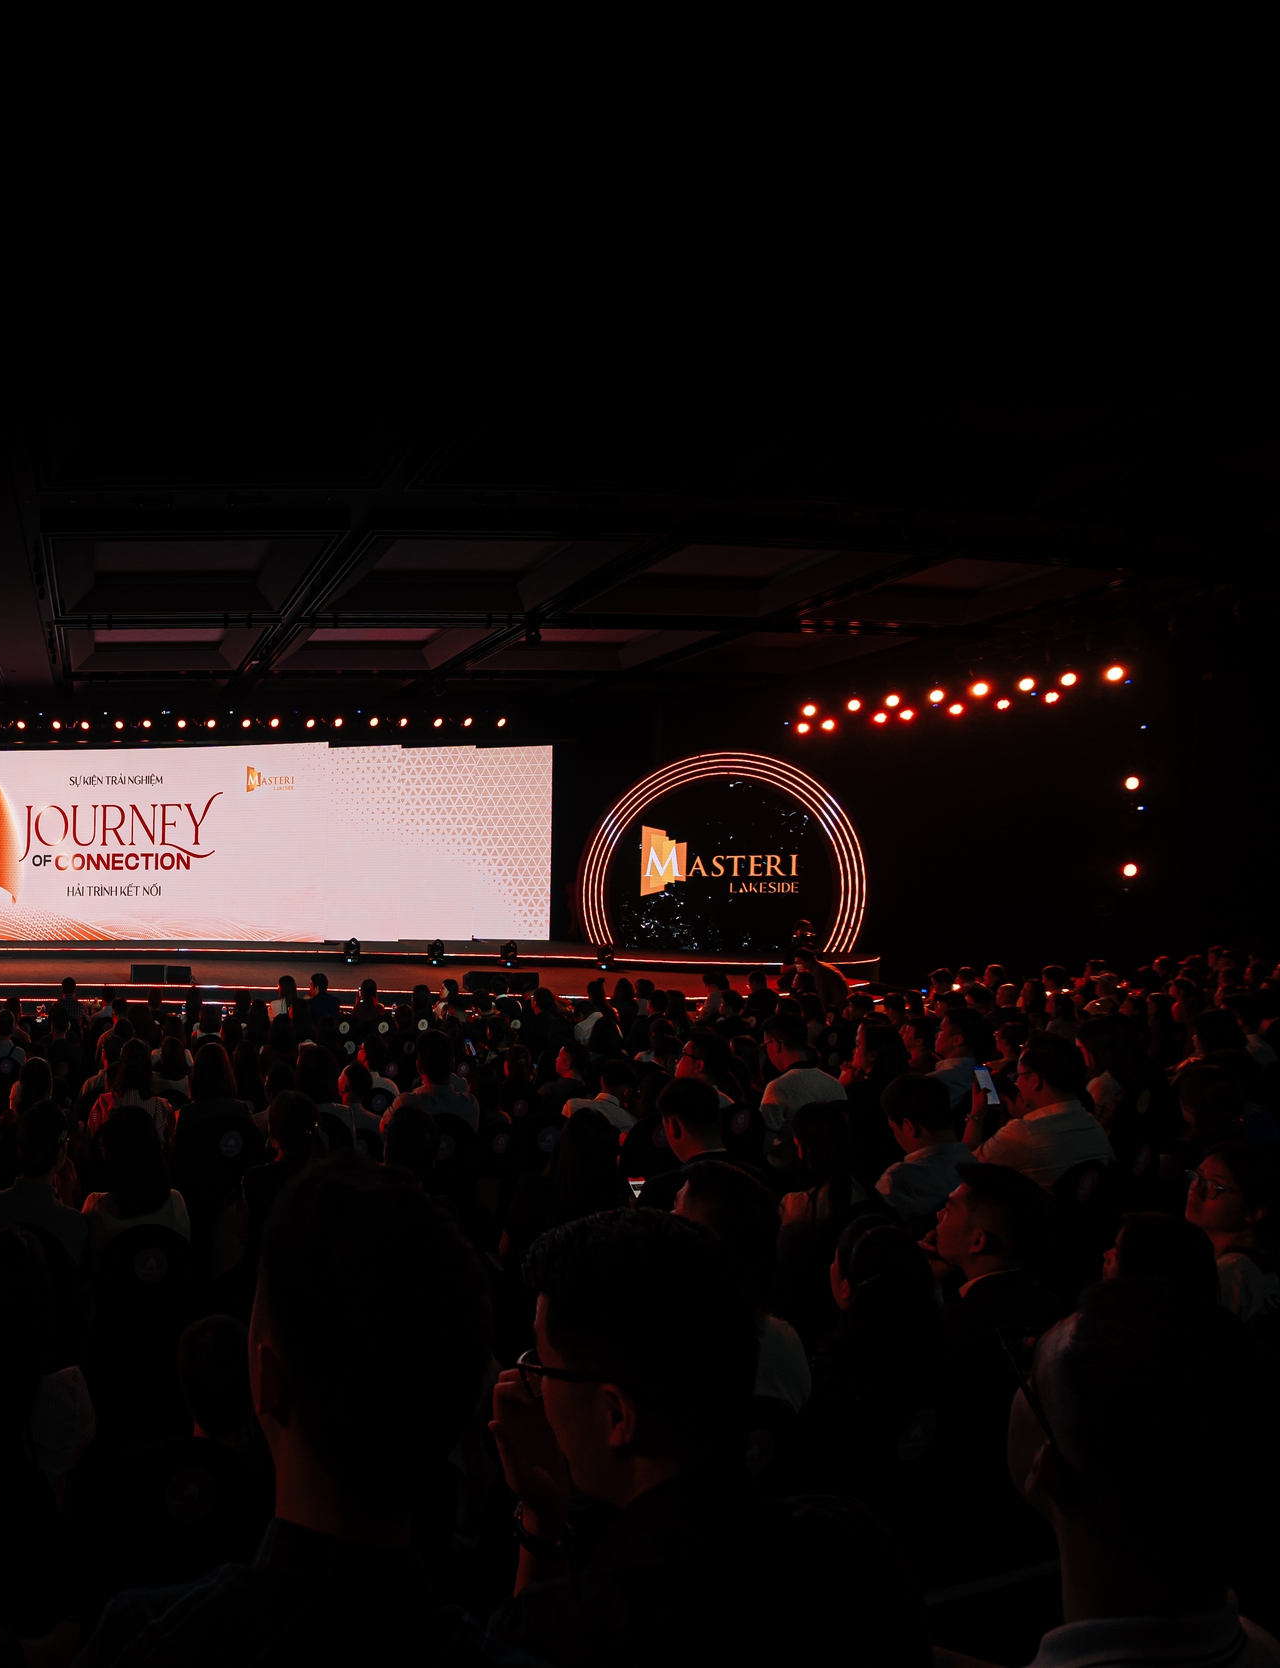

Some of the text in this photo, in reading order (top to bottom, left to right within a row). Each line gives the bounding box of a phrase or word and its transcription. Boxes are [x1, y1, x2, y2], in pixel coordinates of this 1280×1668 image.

[69, 773, 163, 788] SỰ KIỆN TRẢI NGHIỆM
[248, 774, 295, 786] MASTERI
[19, 792, 223, 862] JOURNEY
[32, 853, 191, 871] OF CONNECTION
[644, 846, 799, 877] MASTERI
[67, 883, 162, 897] HẢI TRÌNH KẾT NỐI
[730, 882, 800, 894] LAKESIDE
